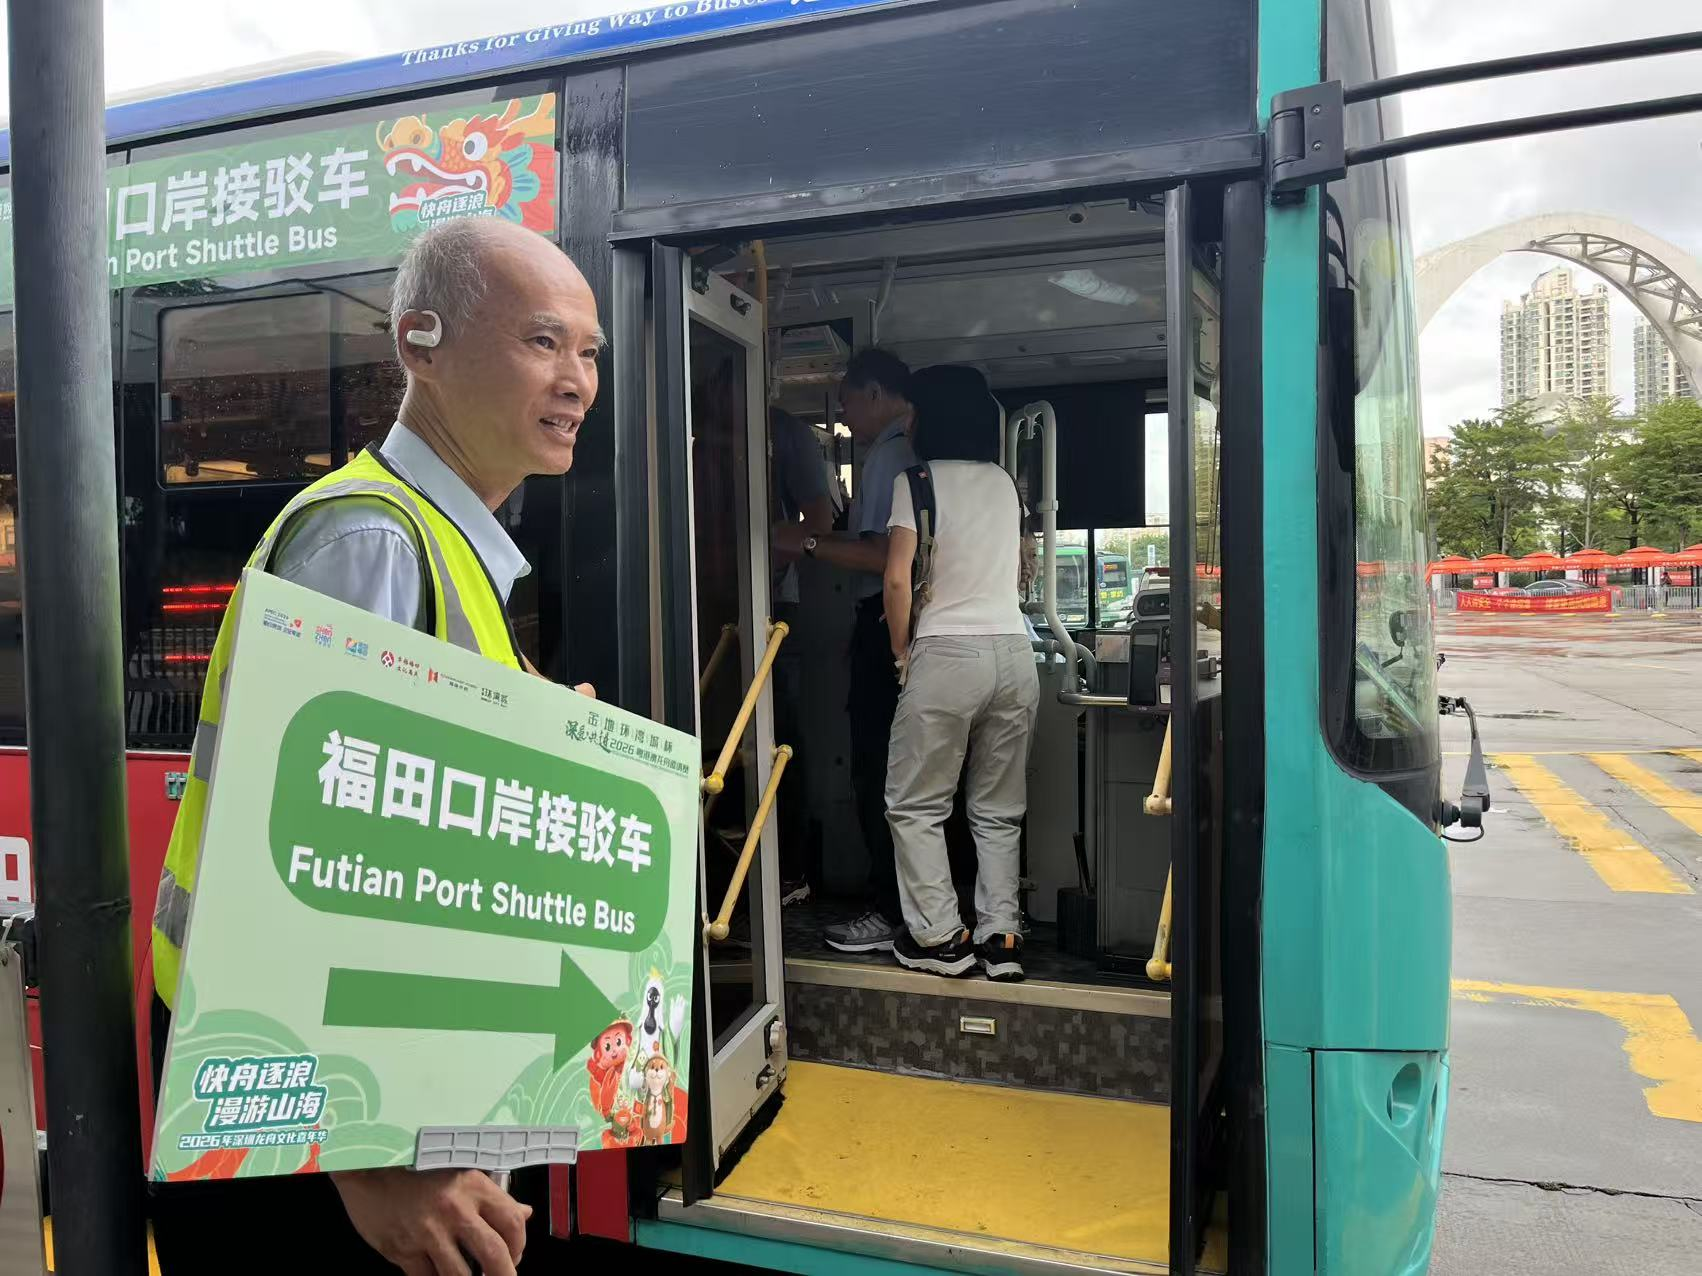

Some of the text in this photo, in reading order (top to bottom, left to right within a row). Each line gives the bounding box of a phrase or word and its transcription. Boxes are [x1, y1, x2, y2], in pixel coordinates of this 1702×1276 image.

[402, 41, 480, 66] Thanks
[486, 34, 520, 50] for
[525, 18, 601, 42] Giving
[608, 9, 657, 30] Way
[663, 5, 688, 19] to
[106, 146, 370, 240] 口岸接驳车
[126, 243, 179, 273] Port
[186, 230, 280, 265] Shuttle
[288, 225, 338, 252] Bus
[609, 739, 635, 755] 2026
[317, 729, 653, 873] 福田口岸接驳车
[288, 845, 636, 936] Futian Port Shuttle Bus
[200, 1060, 313, 1094] 快舟逐浪
[209, 1091, 323, 1127] 漫游山海
[179, 1131, 328, 1149] 2026年深圳龙舟文化嘉年华
